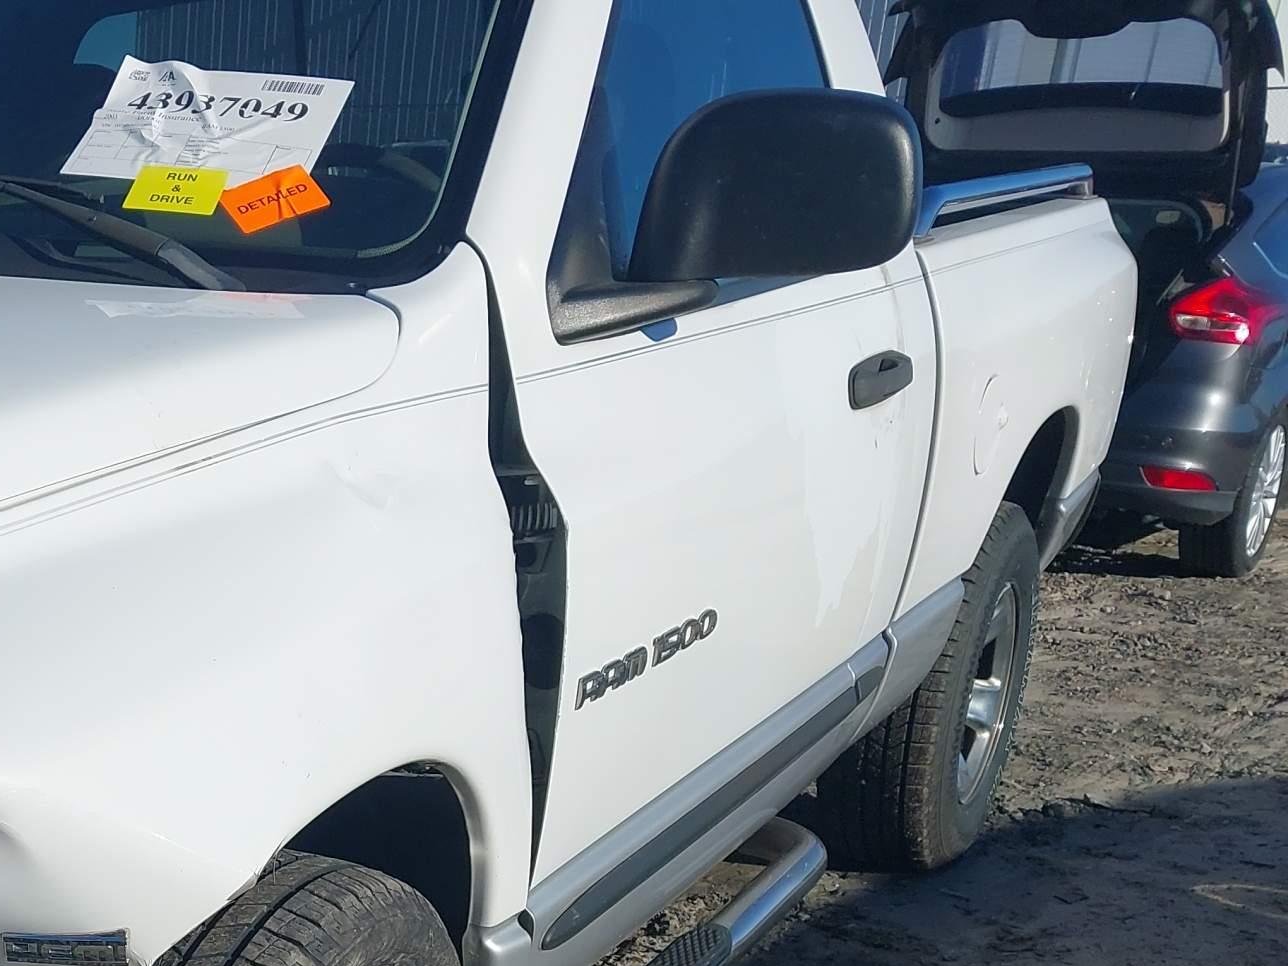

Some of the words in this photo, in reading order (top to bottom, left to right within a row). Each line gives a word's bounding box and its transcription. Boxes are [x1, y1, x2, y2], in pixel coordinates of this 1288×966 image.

[127, 90, 309, 122] 43937049
[166, 172, 198, 182] RUN
[171, 184, 181, 193] &
[237, 183, 308, 214] DETAILED
[149, 194, 194, 205] DRIVE
[651, 608, 718, 668] 1500
